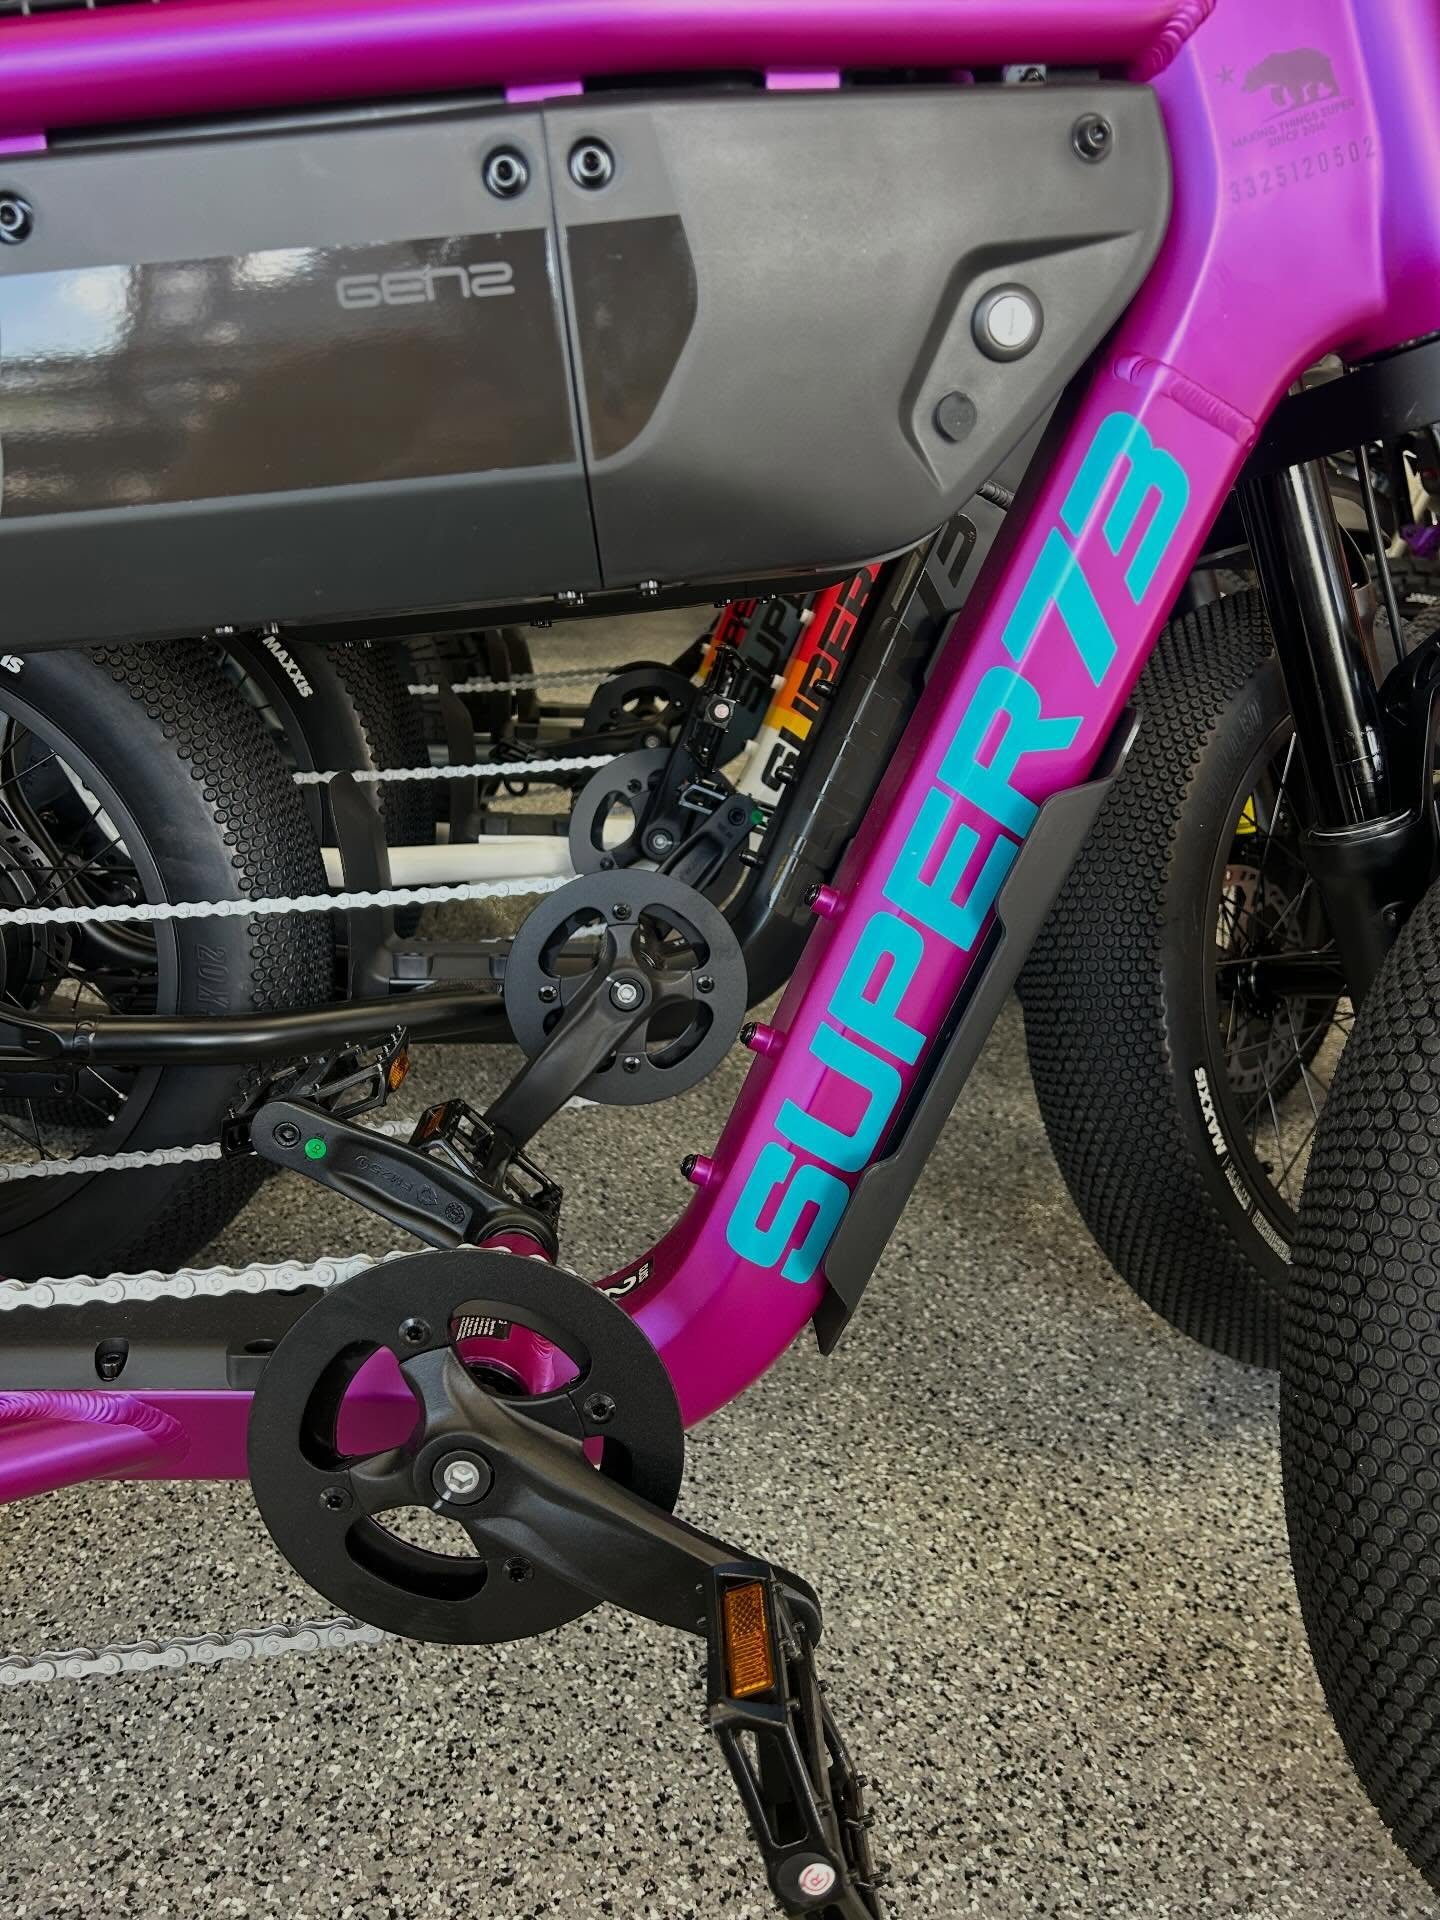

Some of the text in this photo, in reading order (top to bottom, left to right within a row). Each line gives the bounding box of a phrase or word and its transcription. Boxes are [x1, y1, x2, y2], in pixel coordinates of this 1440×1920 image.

[1230, 136, 1375, 202] 3325120502
[262, 635, 313, 698] MAXXIS
[726, 412, 1190, 1284] SUPER73
[1194, 1067, 1228, 1156] MAXXIS
